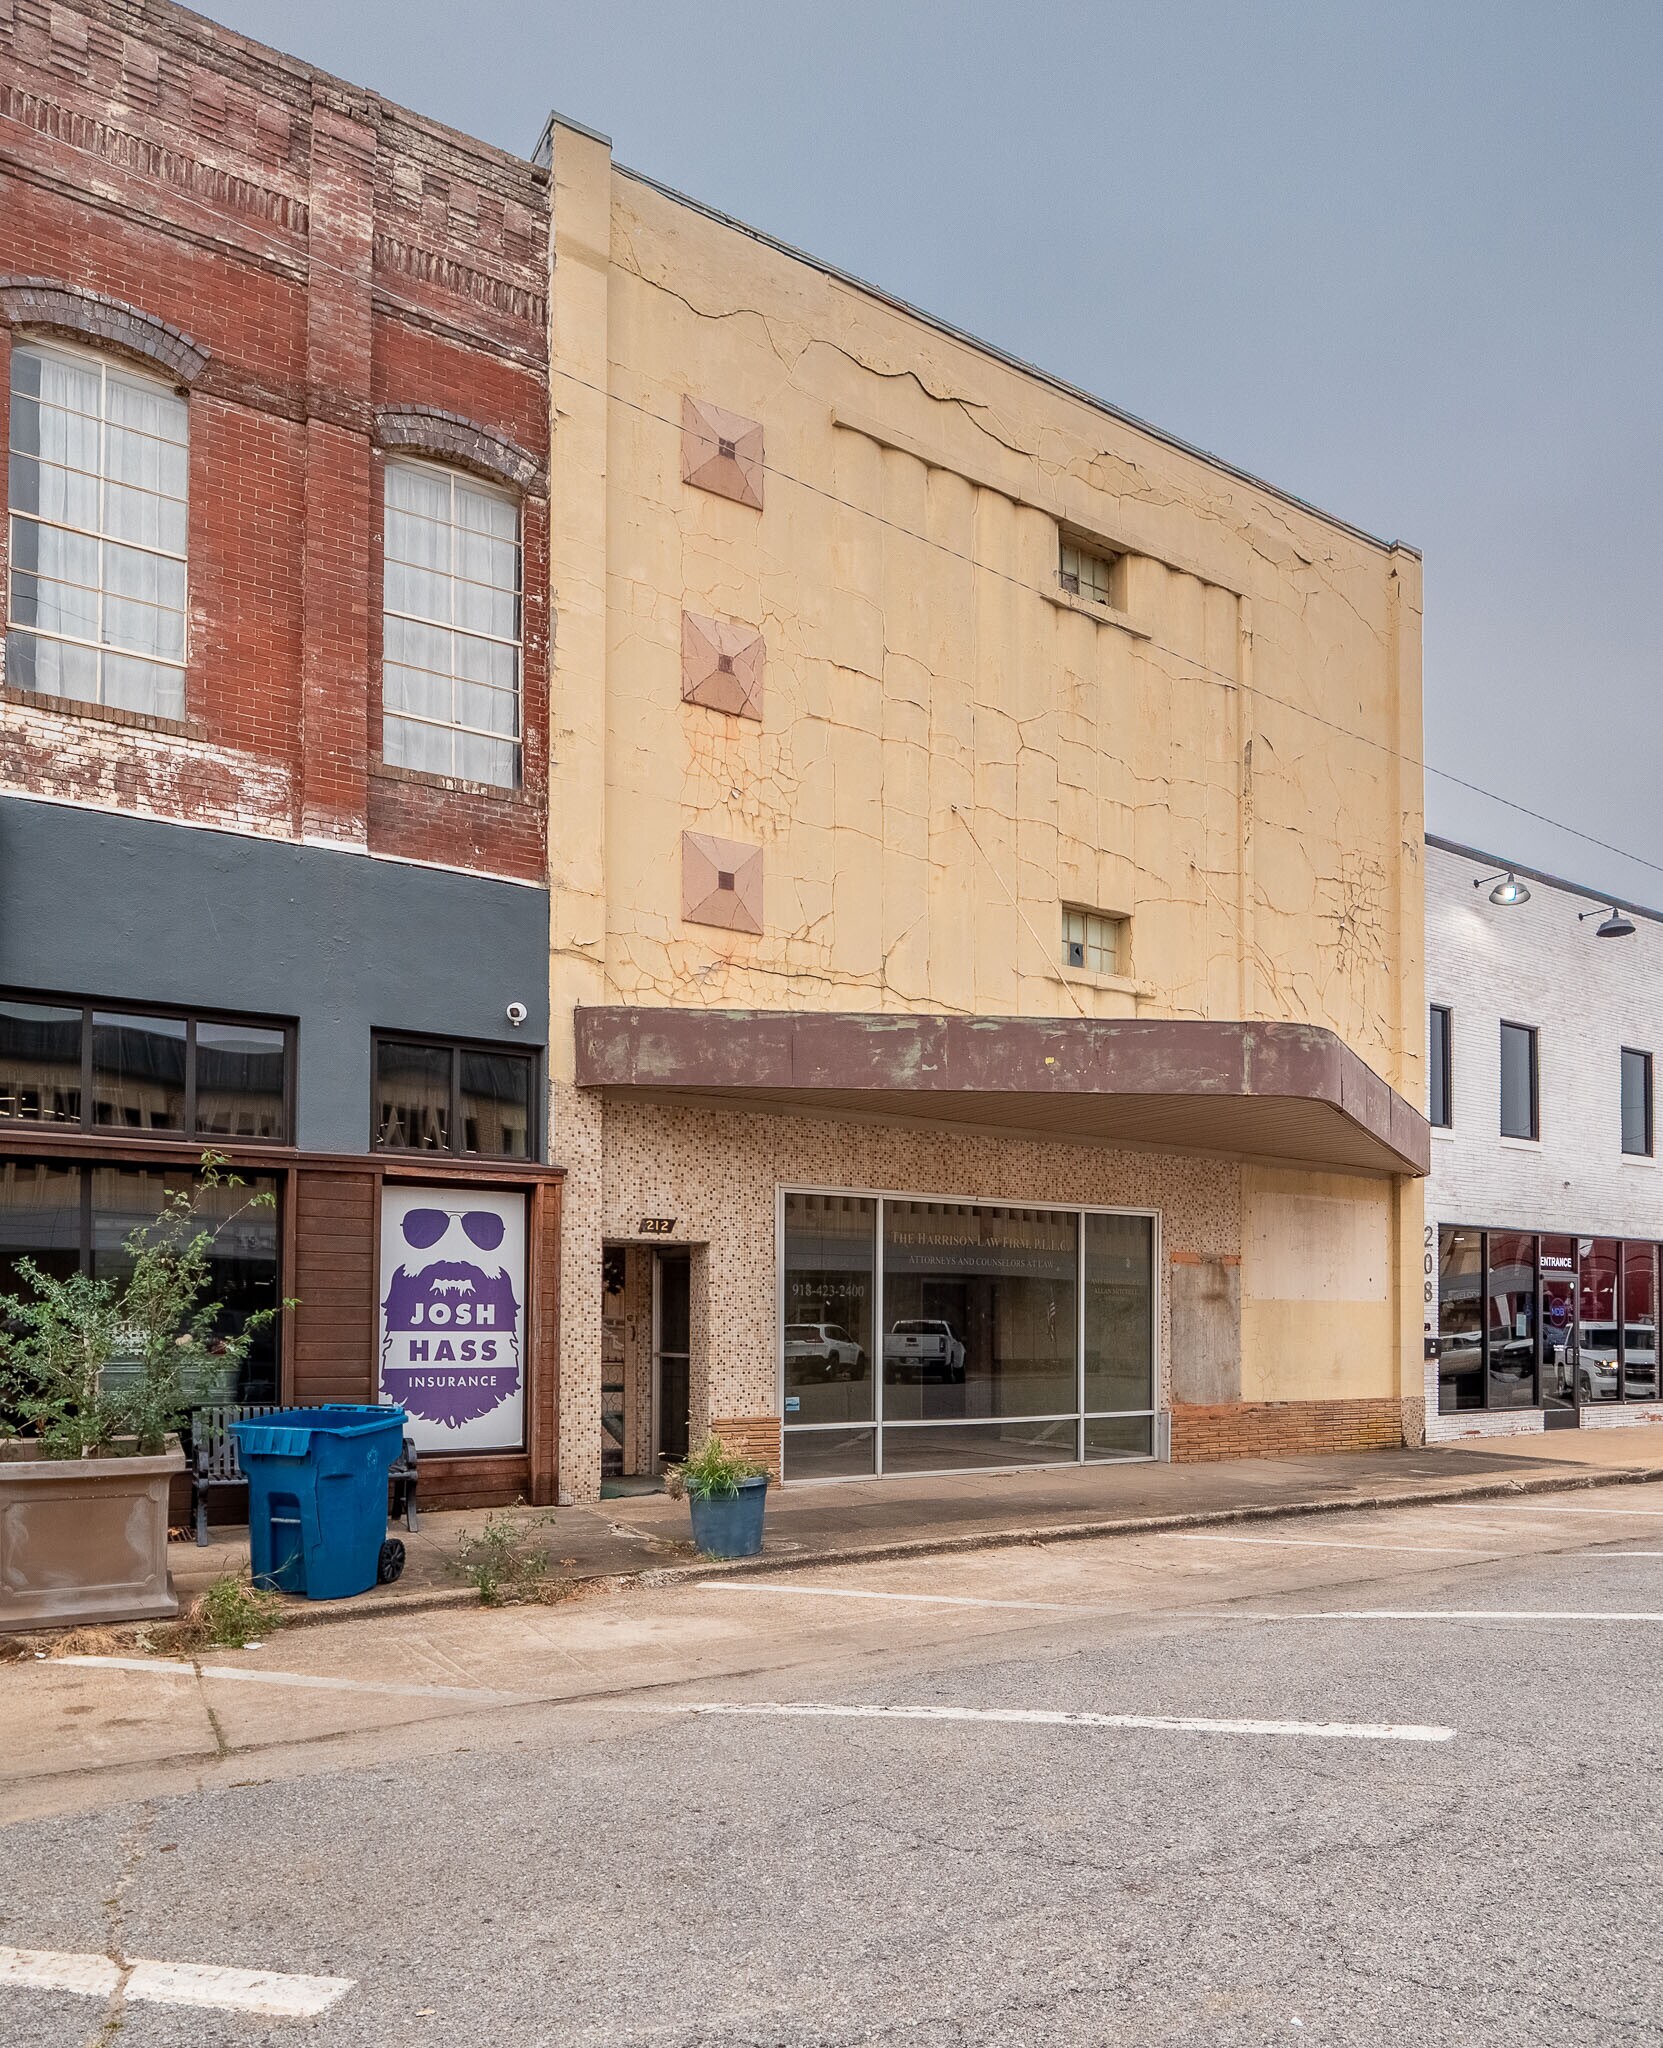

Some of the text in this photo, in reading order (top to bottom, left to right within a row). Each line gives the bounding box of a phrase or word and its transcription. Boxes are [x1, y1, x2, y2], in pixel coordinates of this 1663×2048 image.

[646, 1219, 669, 1231] 212
[918, 1232, 975, 1246] HARRISON
[977, 1234, 1000, 1247] LAW
[909, 1255, 956, 1265] ATTORNEYS
[958, 1257, 975, 1266] AND
[976, 1257, 1025, 1268] COUNSELORS
[1424, 1226, 1433, 1302] 208
[1540, 1256, 1572, 1268] ENTRANCE
[792, 1282, 865, 1297] 918-423-2400
[410, 1302, 495, 1325] JOSH
[409, 1339, 497, 1362] HASS
[408, 1375, 497, 1388] INSURANCE
